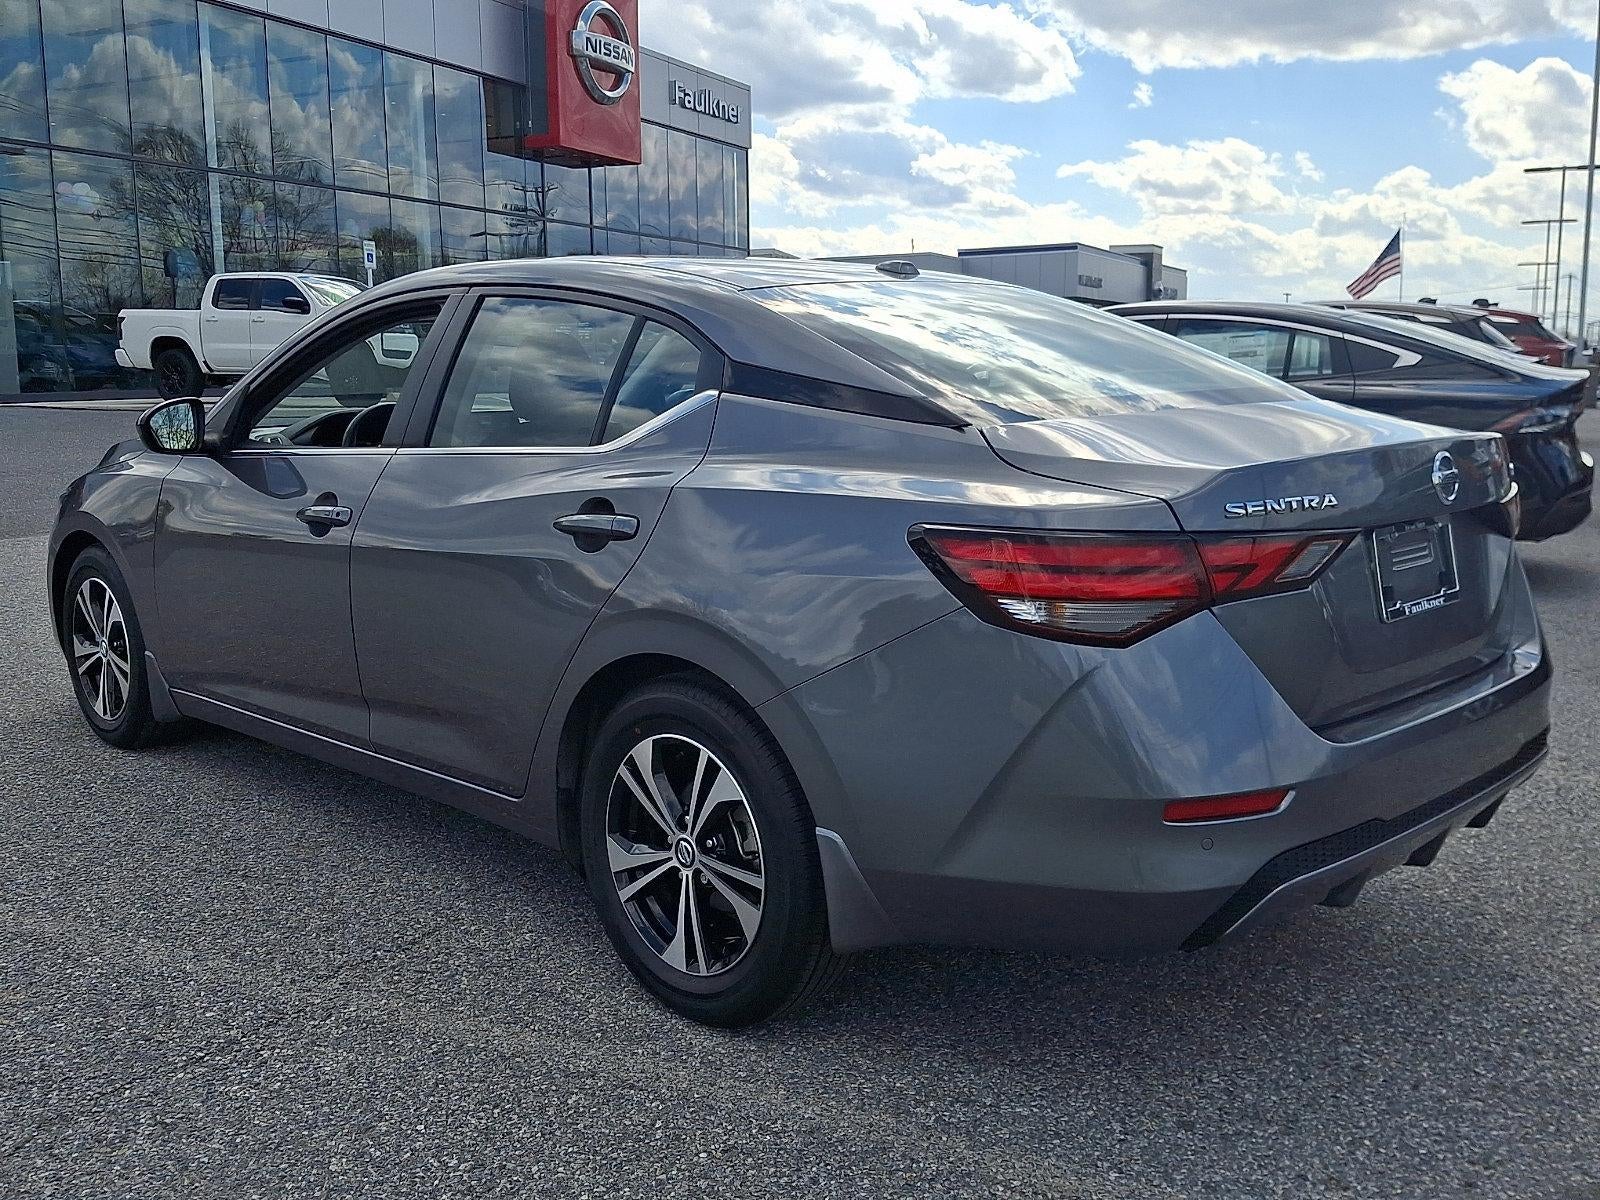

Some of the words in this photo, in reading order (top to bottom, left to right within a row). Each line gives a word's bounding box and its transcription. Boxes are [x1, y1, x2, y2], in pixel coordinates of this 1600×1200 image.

[585, 36, 634, 68] NISSAN
[670, 79, 743, 124] Faulkner
[1224, 493, 1338, 519] SENTRA
[1404, 597, 1446, 616] Faulkner
